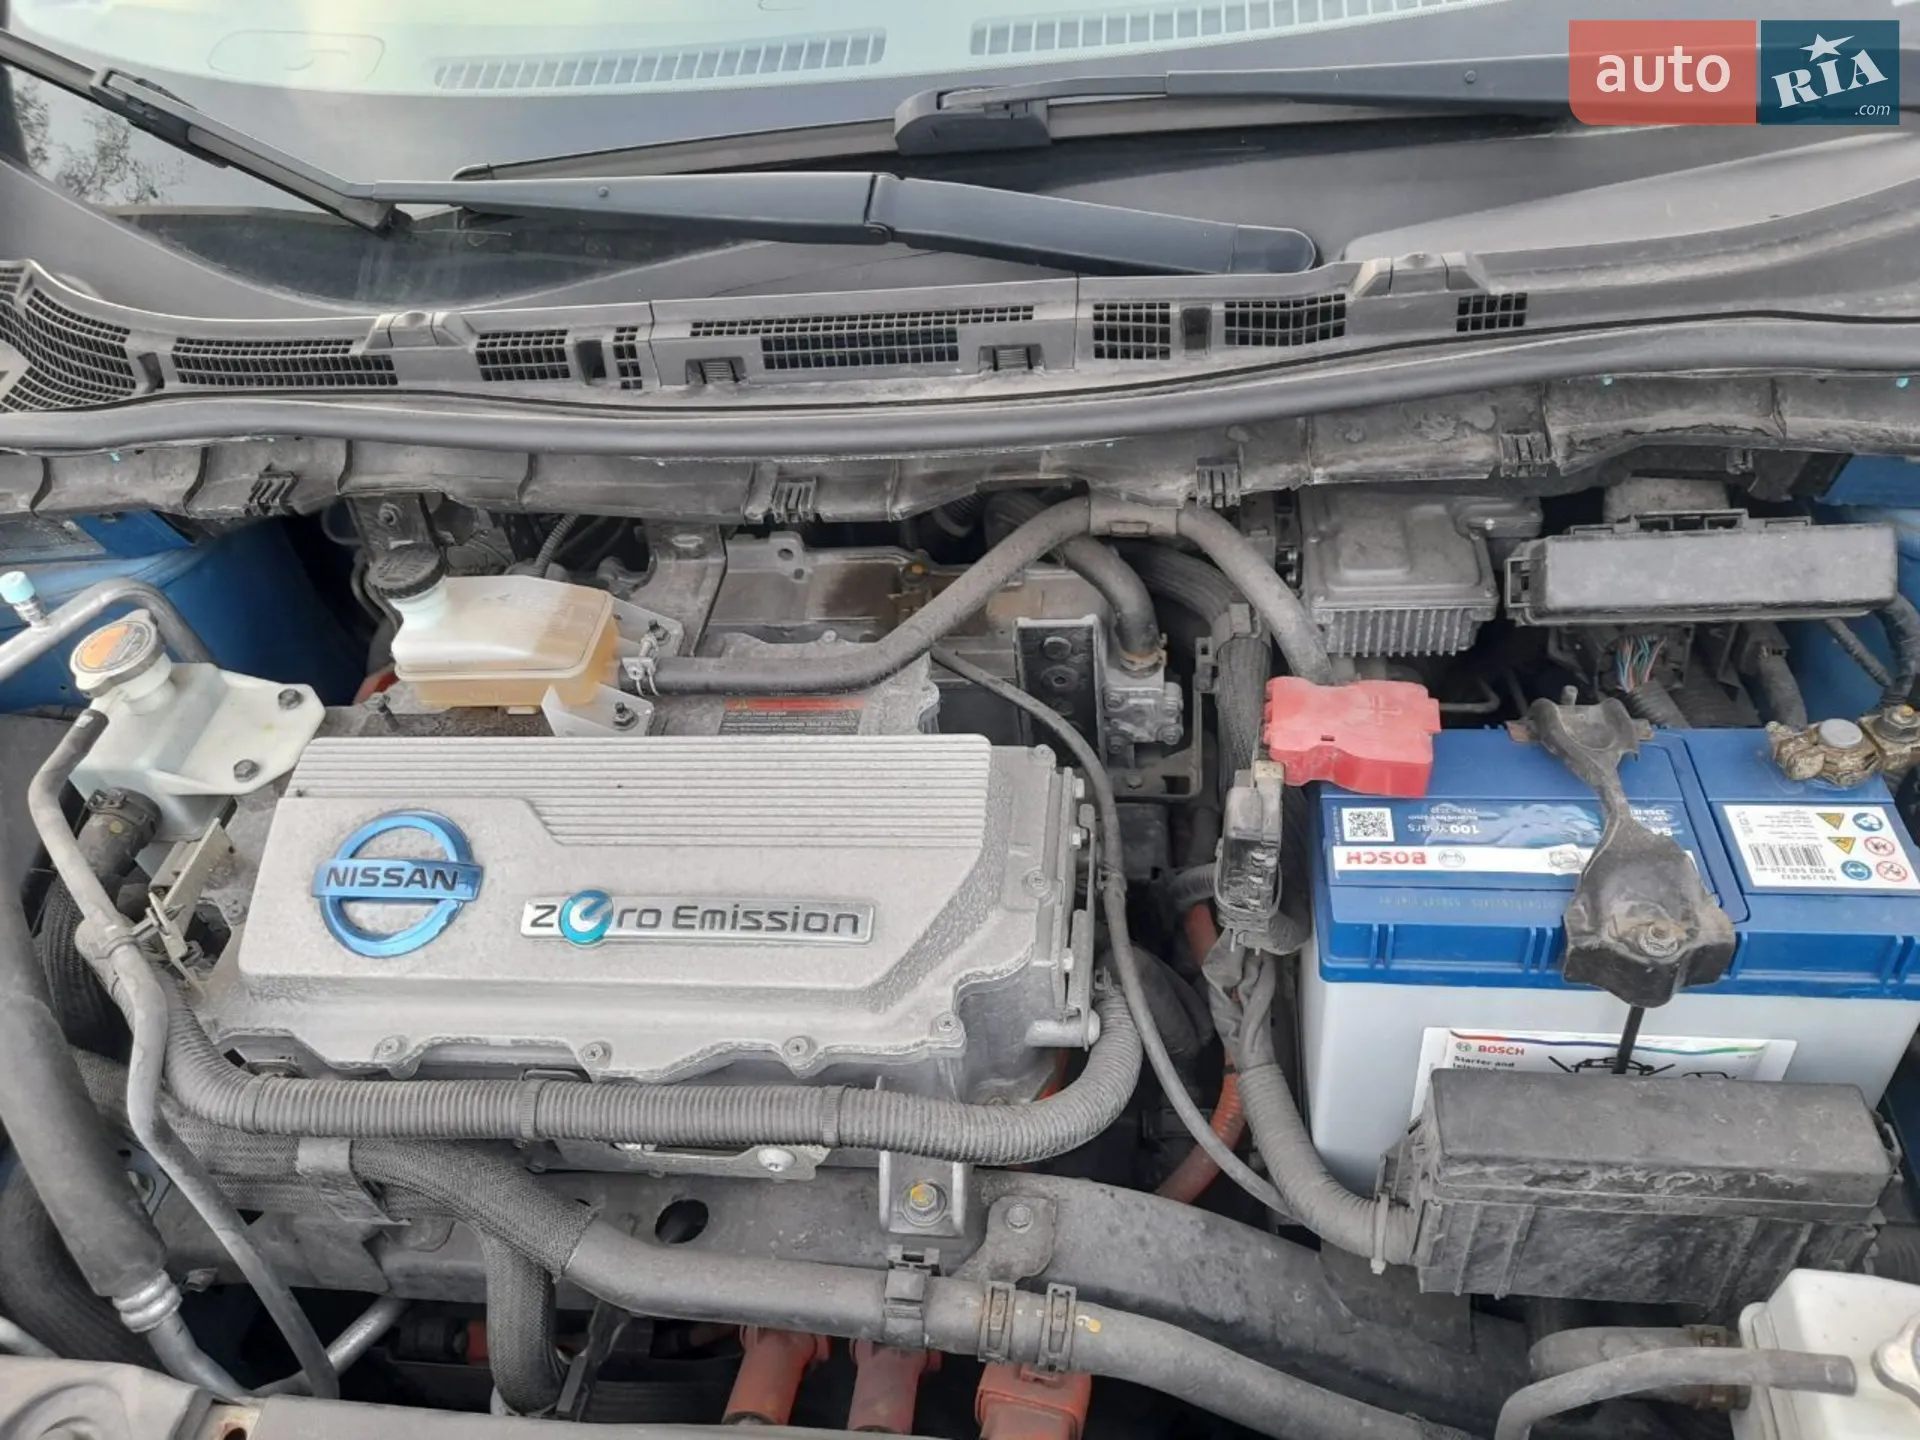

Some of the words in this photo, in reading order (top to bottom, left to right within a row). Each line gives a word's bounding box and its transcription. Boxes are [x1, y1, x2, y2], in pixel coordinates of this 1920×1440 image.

[1407, 823, 1448, 834] Years
[1449, 824, 1479, 834] 100
[1346, 851, 1427, 865] BOSCH
[324, 866, 460, 892] NISSAN
[672, 905, 860, 935] Emission
[1478, 1045, 1525, 1056] BOSCH
[1454, 1055, 1492, 1065] Starter
